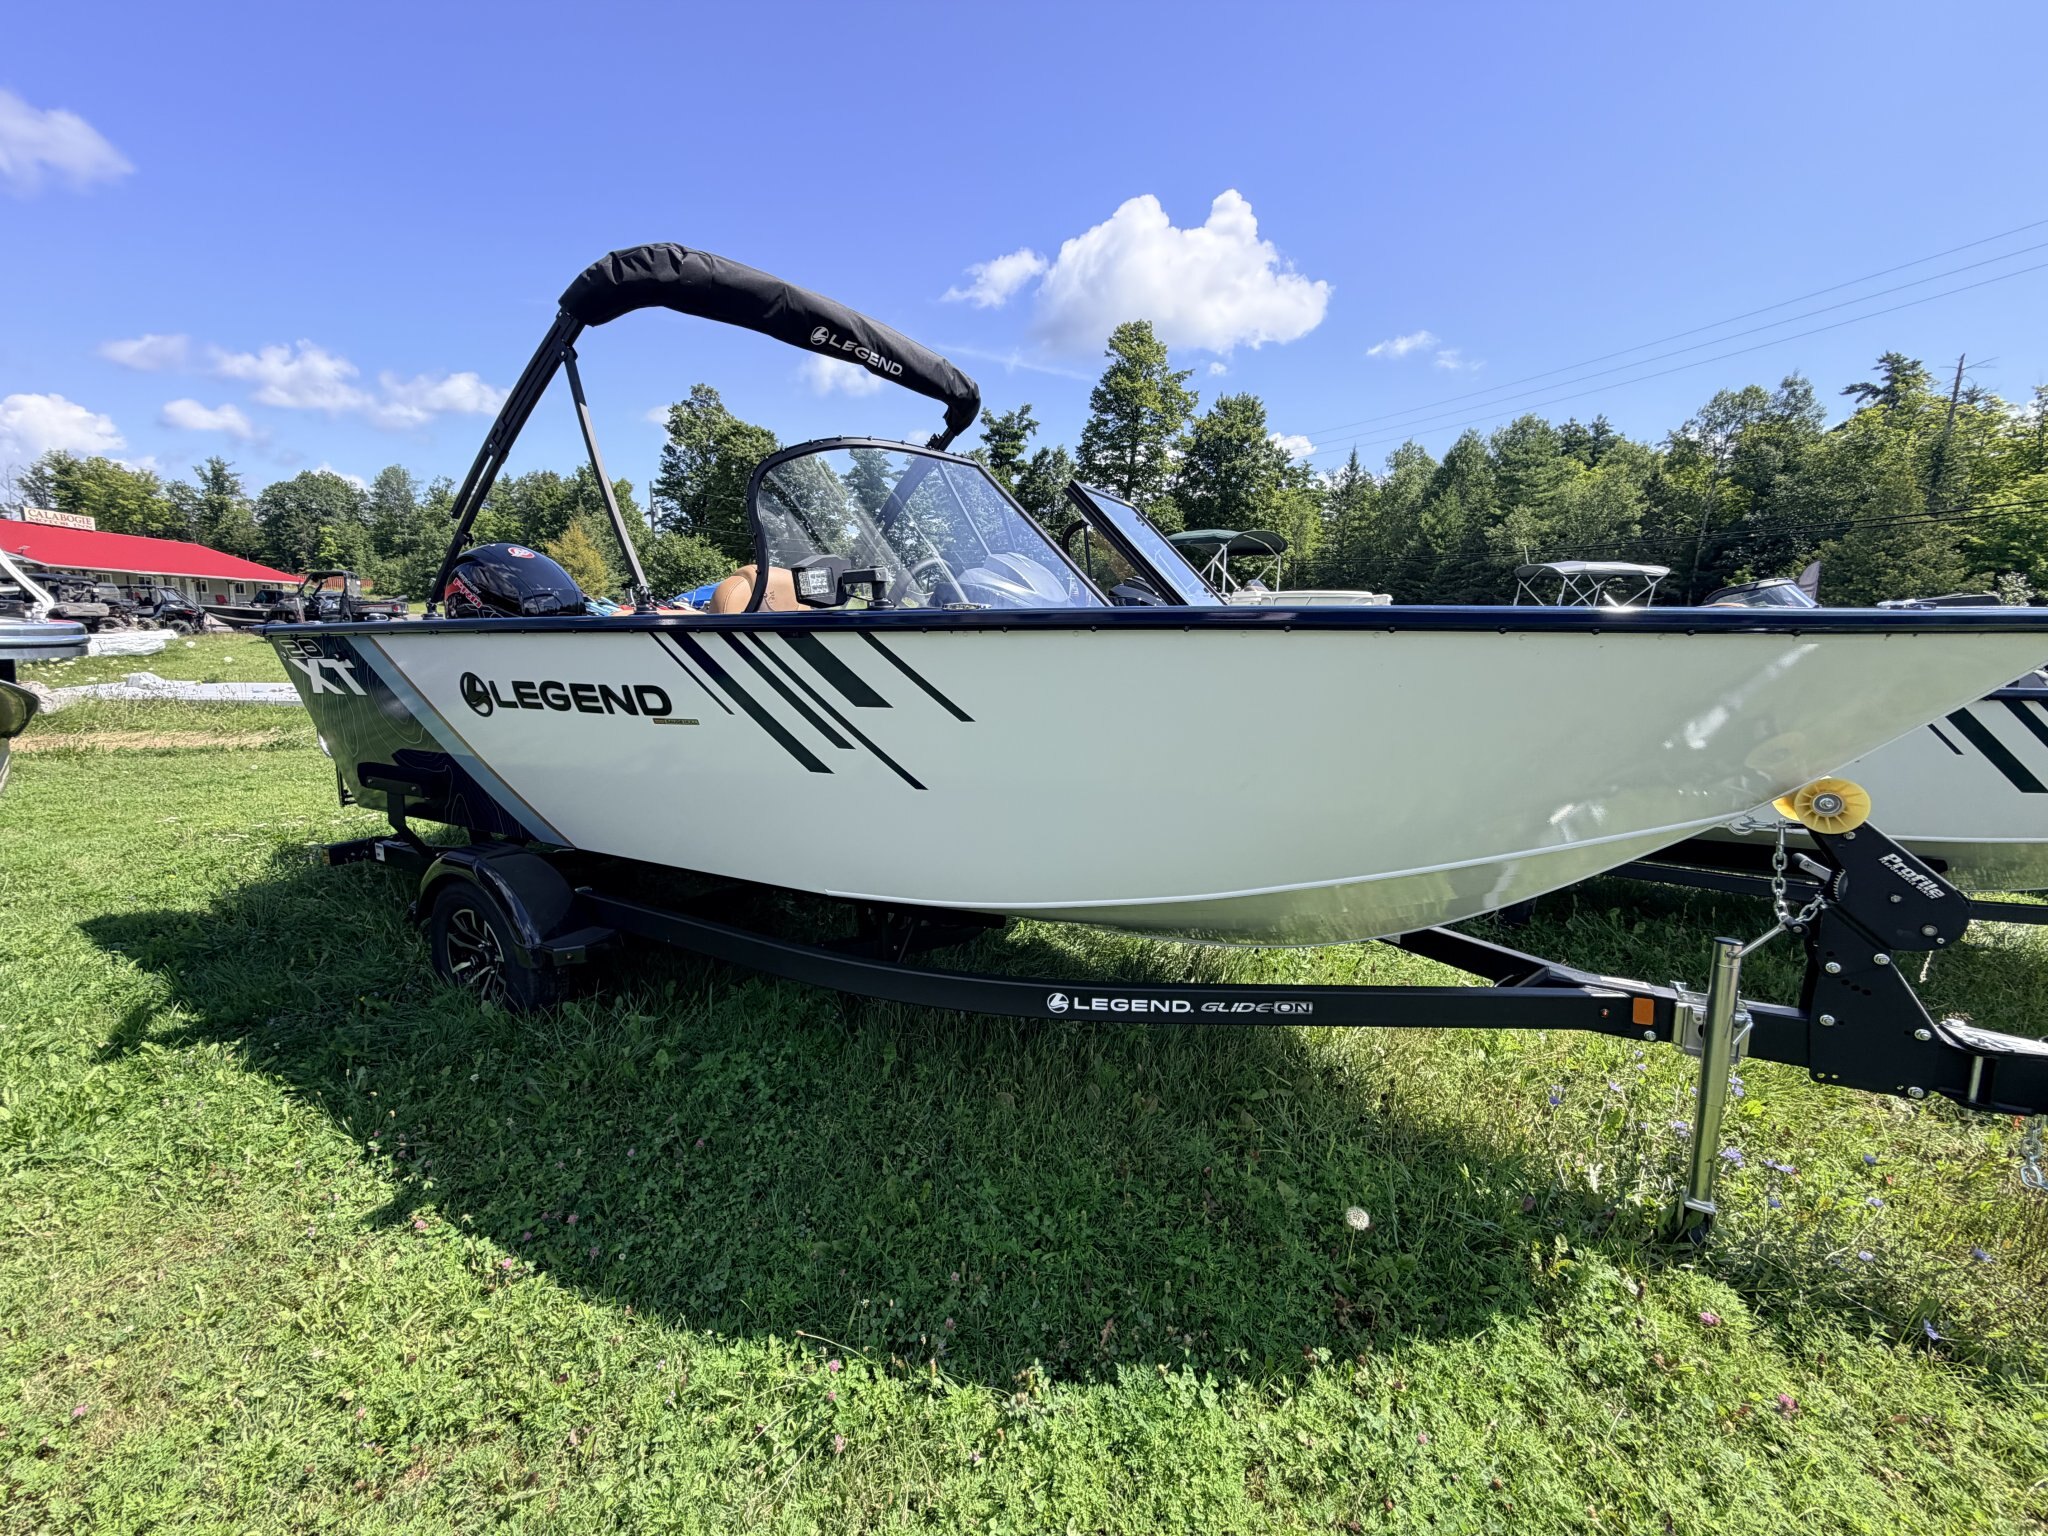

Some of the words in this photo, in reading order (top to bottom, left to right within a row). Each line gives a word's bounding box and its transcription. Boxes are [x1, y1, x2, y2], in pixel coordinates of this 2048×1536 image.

[828, 334, 903, 375] LEGEND
[28, 509, 92, 525] CALABOGIE
[458, 571, 481, 594] MERCURY
[279, 639, 324, 658] 20
[288, 659, 368, 695] XT
[488, 680, 672, 717] LEGEND
[1882, 853, 1946, 898] Profile
[1073, 997, 1191, 1014] LEGEND
